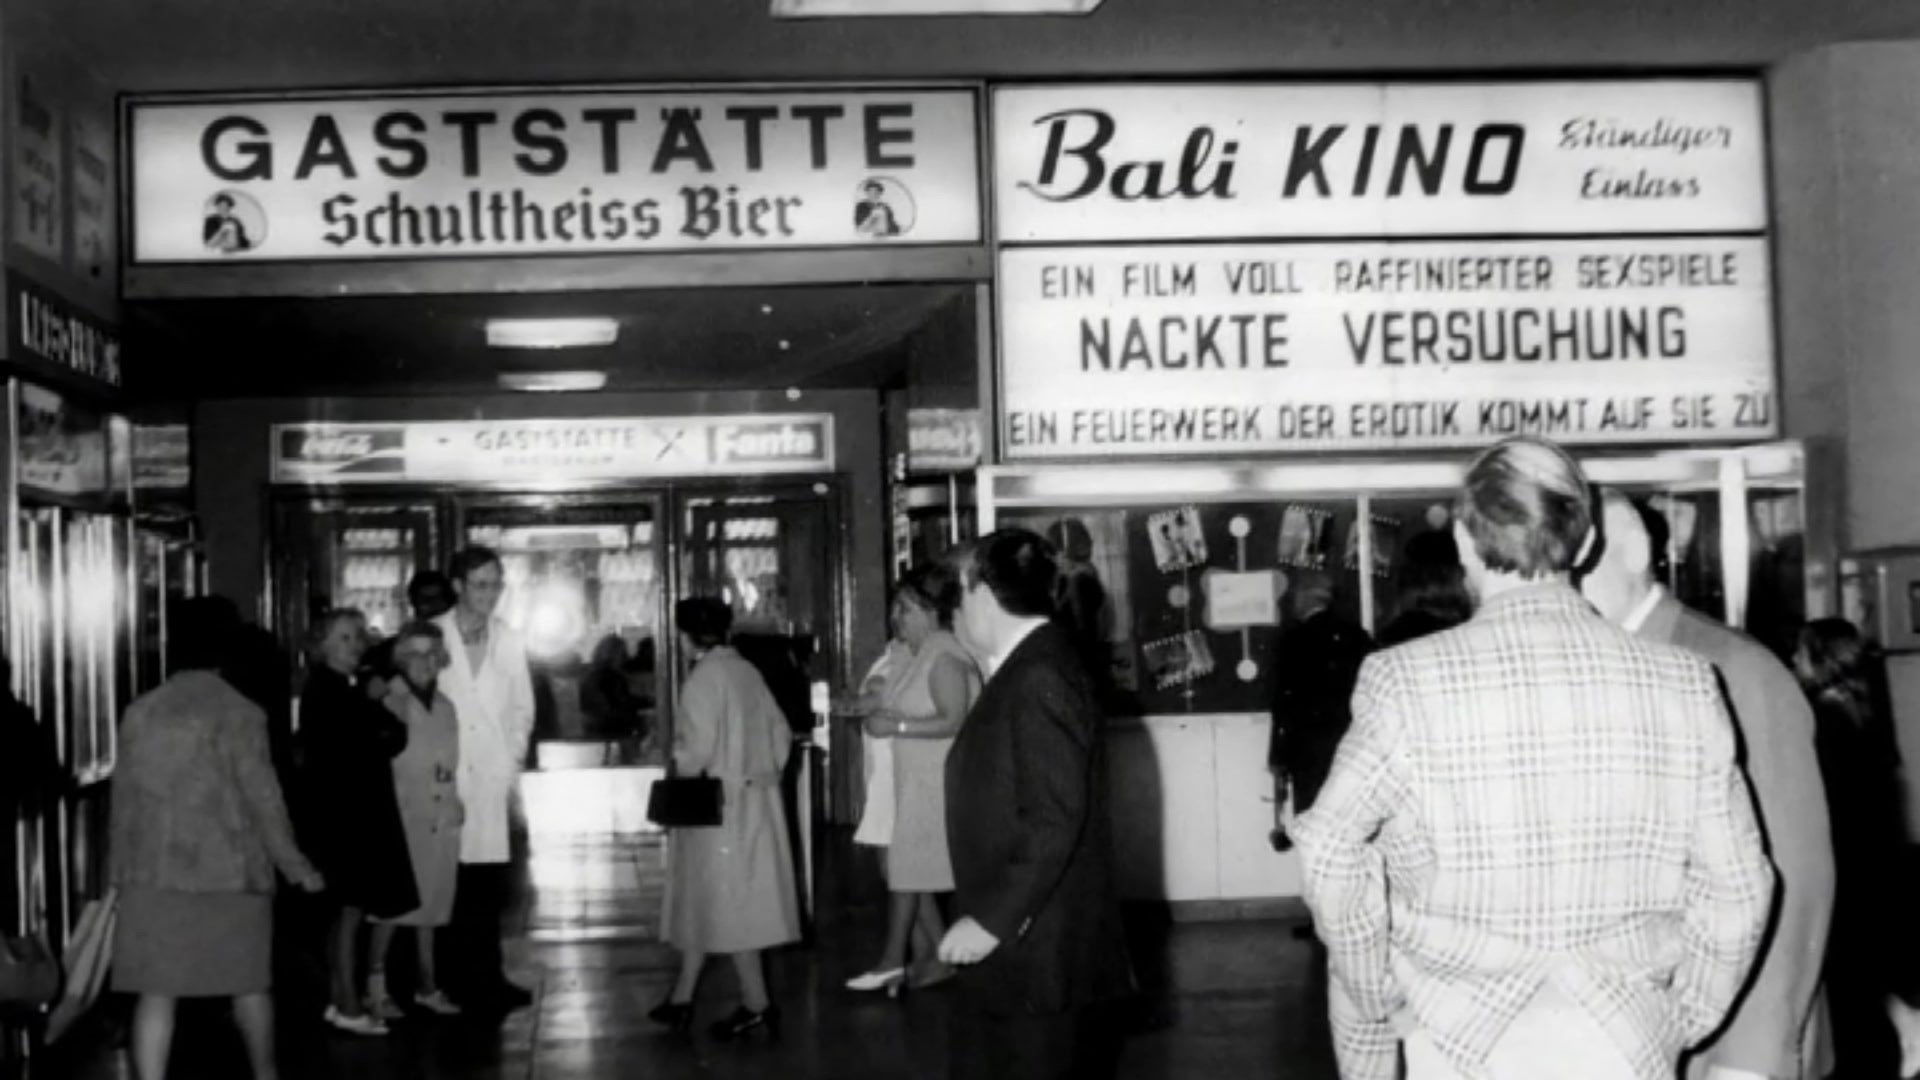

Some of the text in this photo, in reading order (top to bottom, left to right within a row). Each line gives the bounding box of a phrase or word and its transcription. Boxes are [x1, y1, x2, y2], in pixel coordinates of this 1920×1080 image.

[201, 103, 916, 181] GASTSTÄTTE
[1017, 108, 1526, 202] Bali KINO
[1578, 167, 1701, 199] Einlass
[321, 185, 804, 247] Schultheiss Bier
[1041, 252, 1739, 298] EIN FILM VOLL RAFFINIERTER SEXSPIELE
[1080, 306, 1687, 371] NACKTE VERSUCHUNG
[1009, 410, 1057, 446] EIN
[1071, 406, 1262, 443] FEUERWERK
[1278, 403, 1335, 440] DER
[1351, 400, 1460, 438] EROTIK
[1478, 398, 1588, 435] KOMMT
[1599, 396, 1654, 431] AUF
[1671, 394, 1716, 429] SIE
[1733, 392, 1772, 428] ZU
